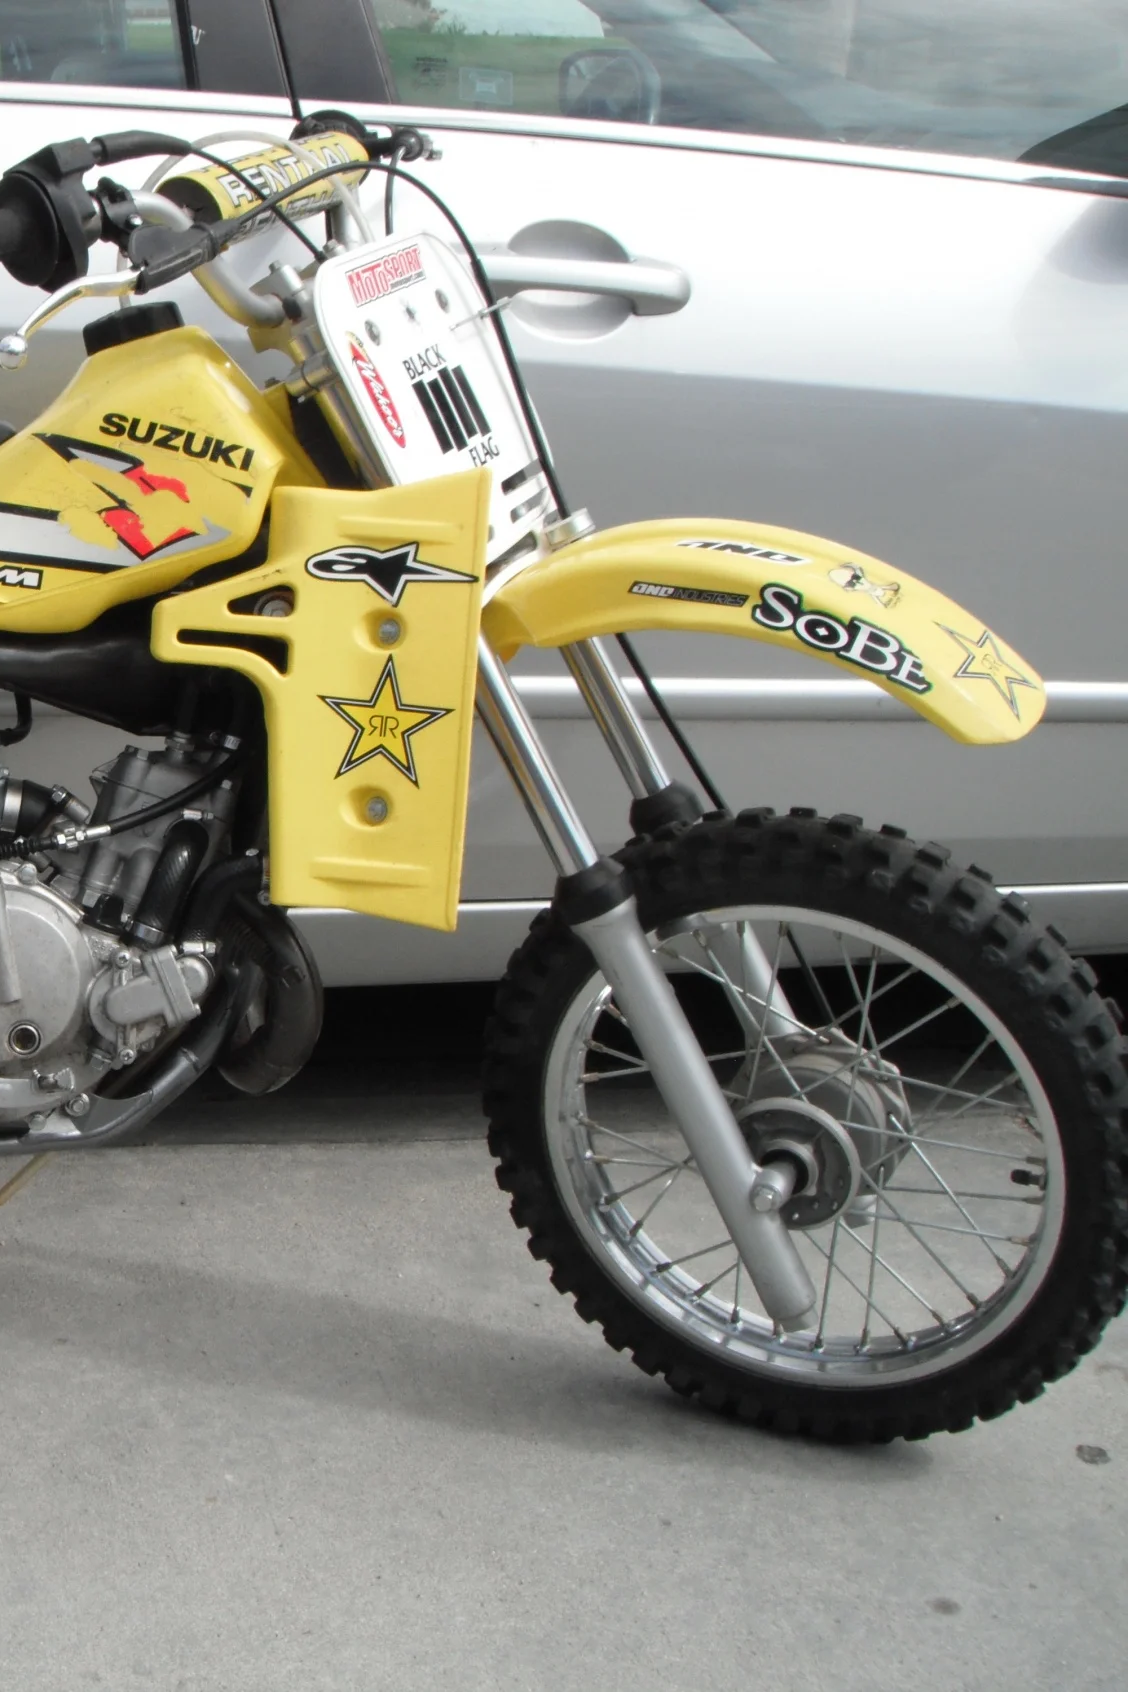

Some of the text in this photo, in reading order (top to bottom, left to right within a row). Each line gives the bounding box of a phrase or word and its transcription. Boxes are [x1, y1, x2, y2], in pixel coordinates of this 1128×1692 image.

[402, 344, 446, 380] BLACK
[99, 413, 255, 472] SUZUKI
[469, 437, 500, 467] FLAG
[673, 588, 747, 606] INDUSTRIES
